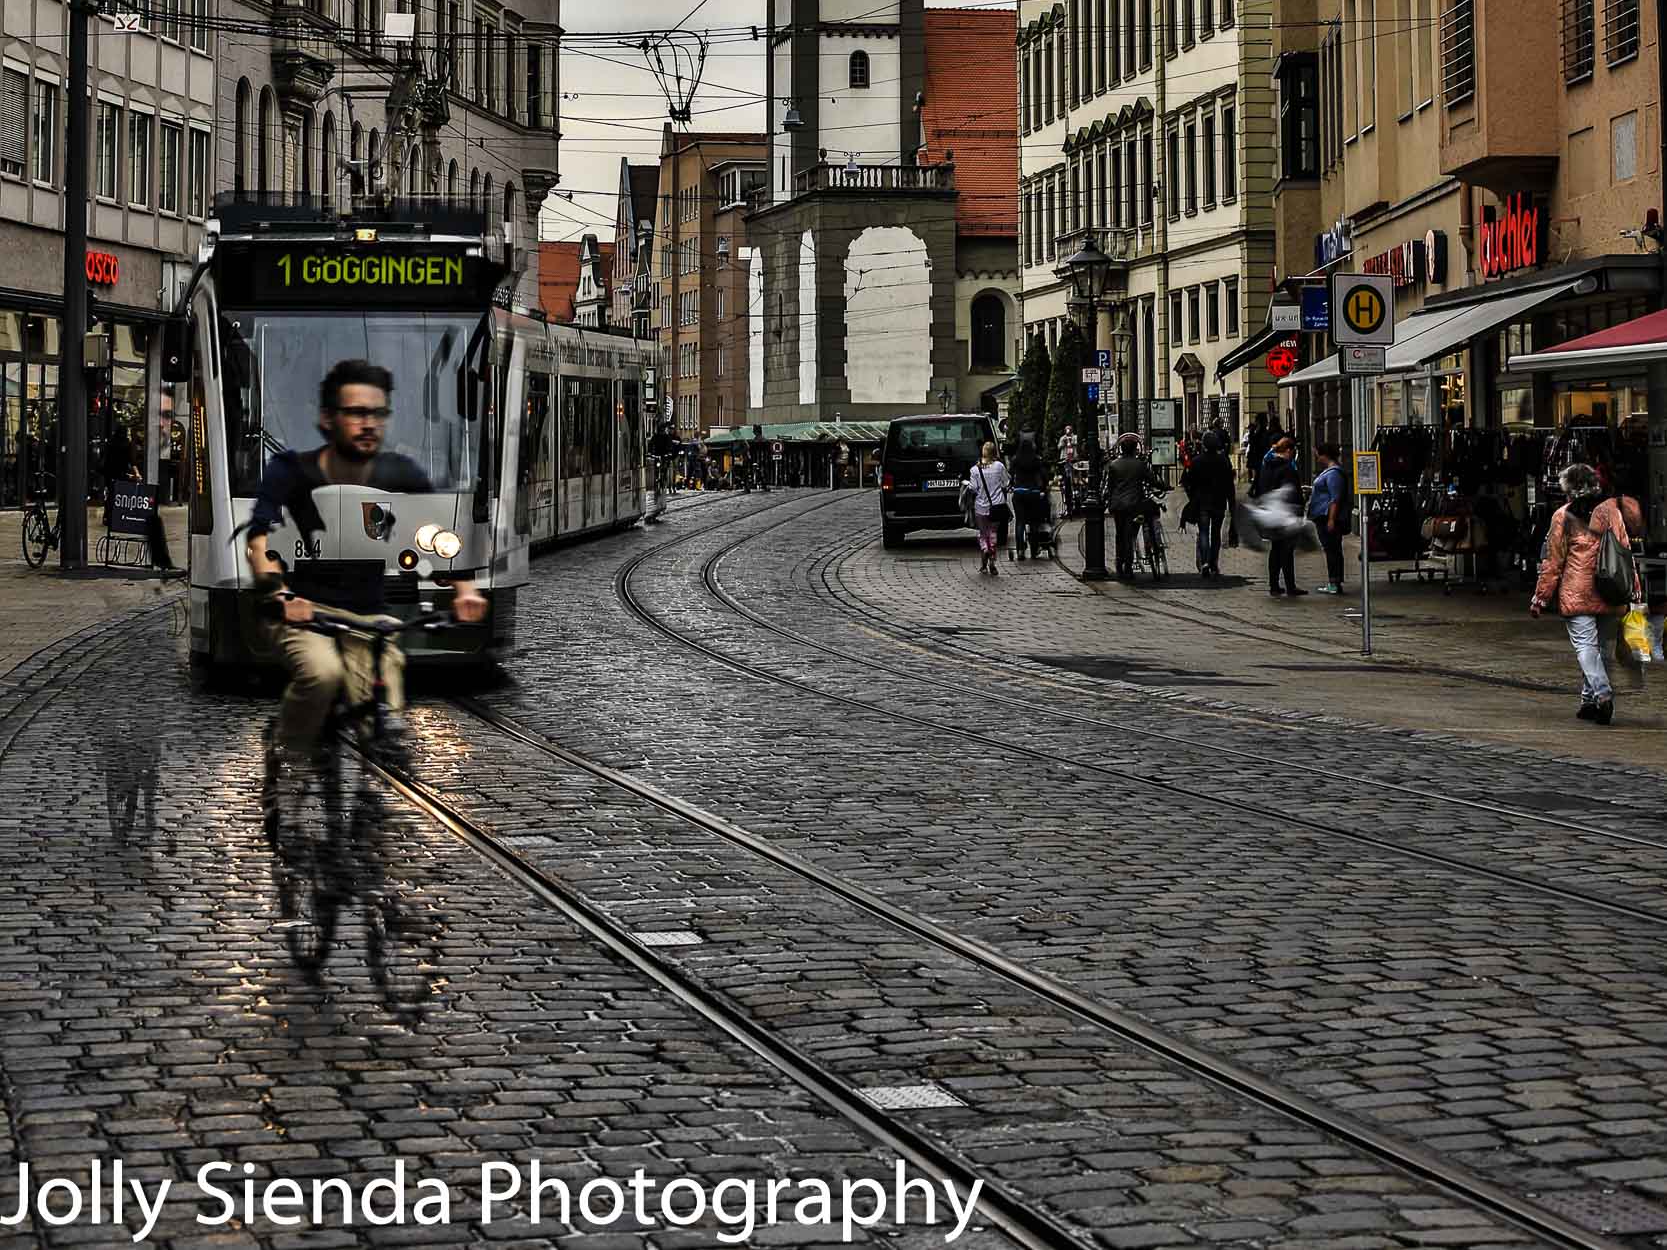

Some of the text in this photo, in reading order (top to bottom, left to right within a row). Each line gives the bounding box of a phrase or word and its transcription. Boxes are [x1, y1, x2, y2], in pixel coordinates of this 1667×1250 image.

[277, 254, 463, 286] 1 GÖGGINGEN
[1355, 296, 1373, 323] H
